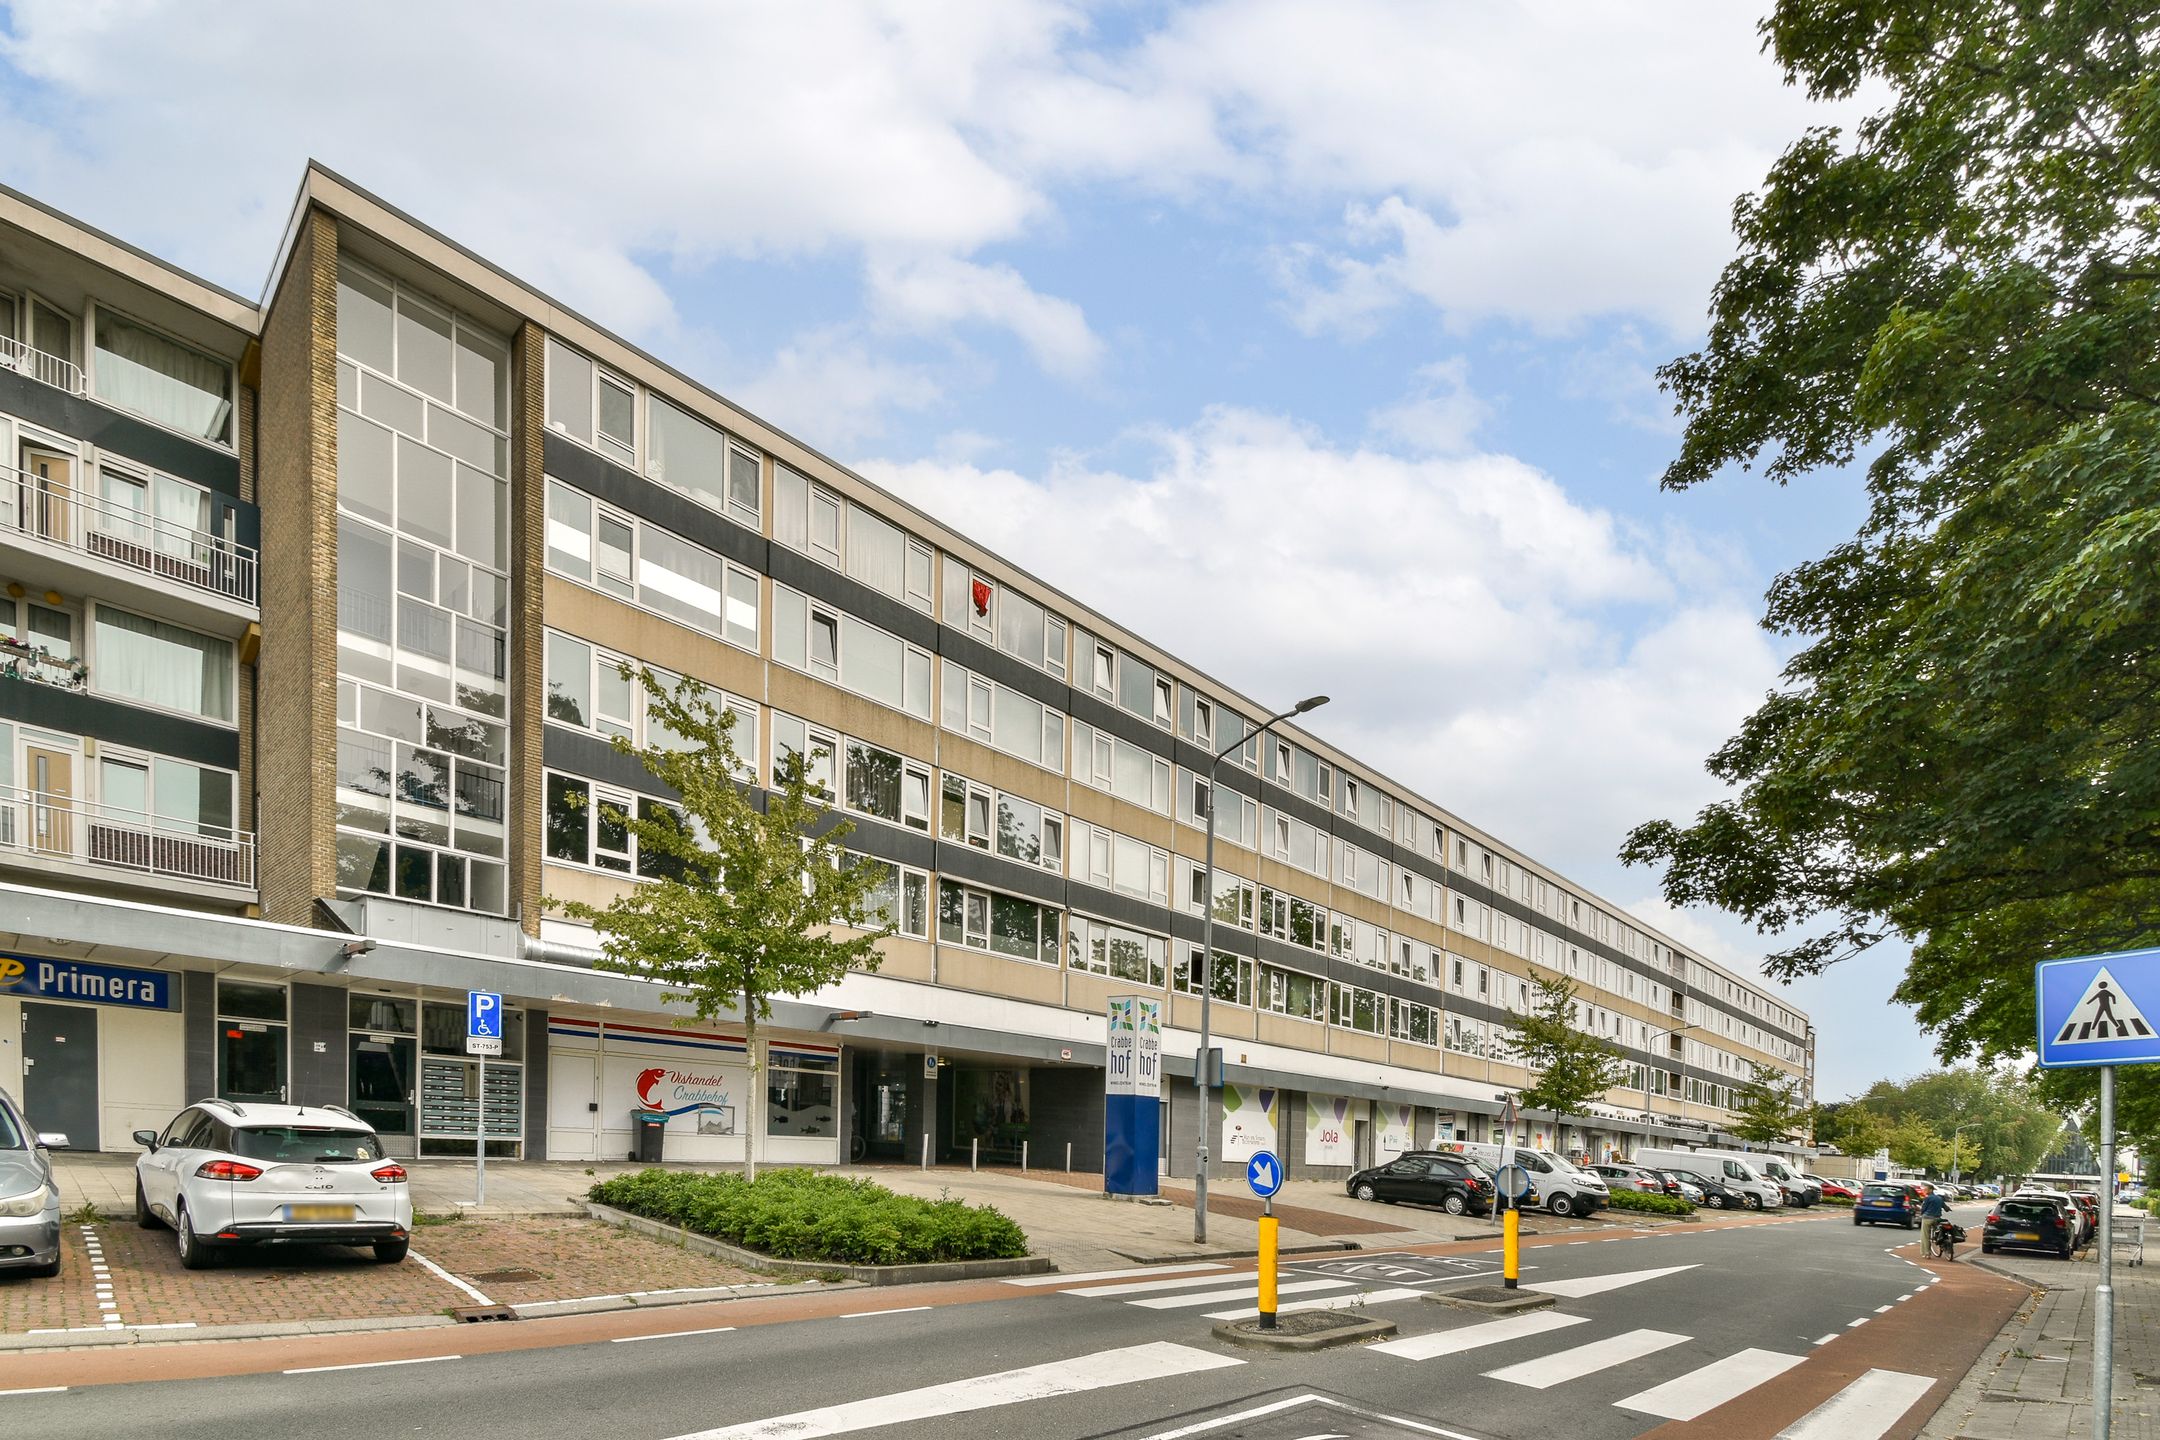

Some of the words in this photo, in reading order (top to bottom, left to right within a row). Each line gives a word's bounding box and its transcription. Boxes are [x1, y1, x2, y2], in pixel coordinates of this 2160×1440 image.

[39, 962, 155, 1002] Primera
[476, 995, 494, 1018] P
[1110, 1036, 1132, 1048] Crabbe
[1139, 1036, 1158, 1050] Crabbe
[1110, 1050, 1132, 1079] hof
[1139, 1051, 1158, 1080] hof
[668, 1071, 723, 1087] Vishandel
[673, 1085, 729, 1106] Crabbehof
[1320, 1129, 1339, 1144] Jola
